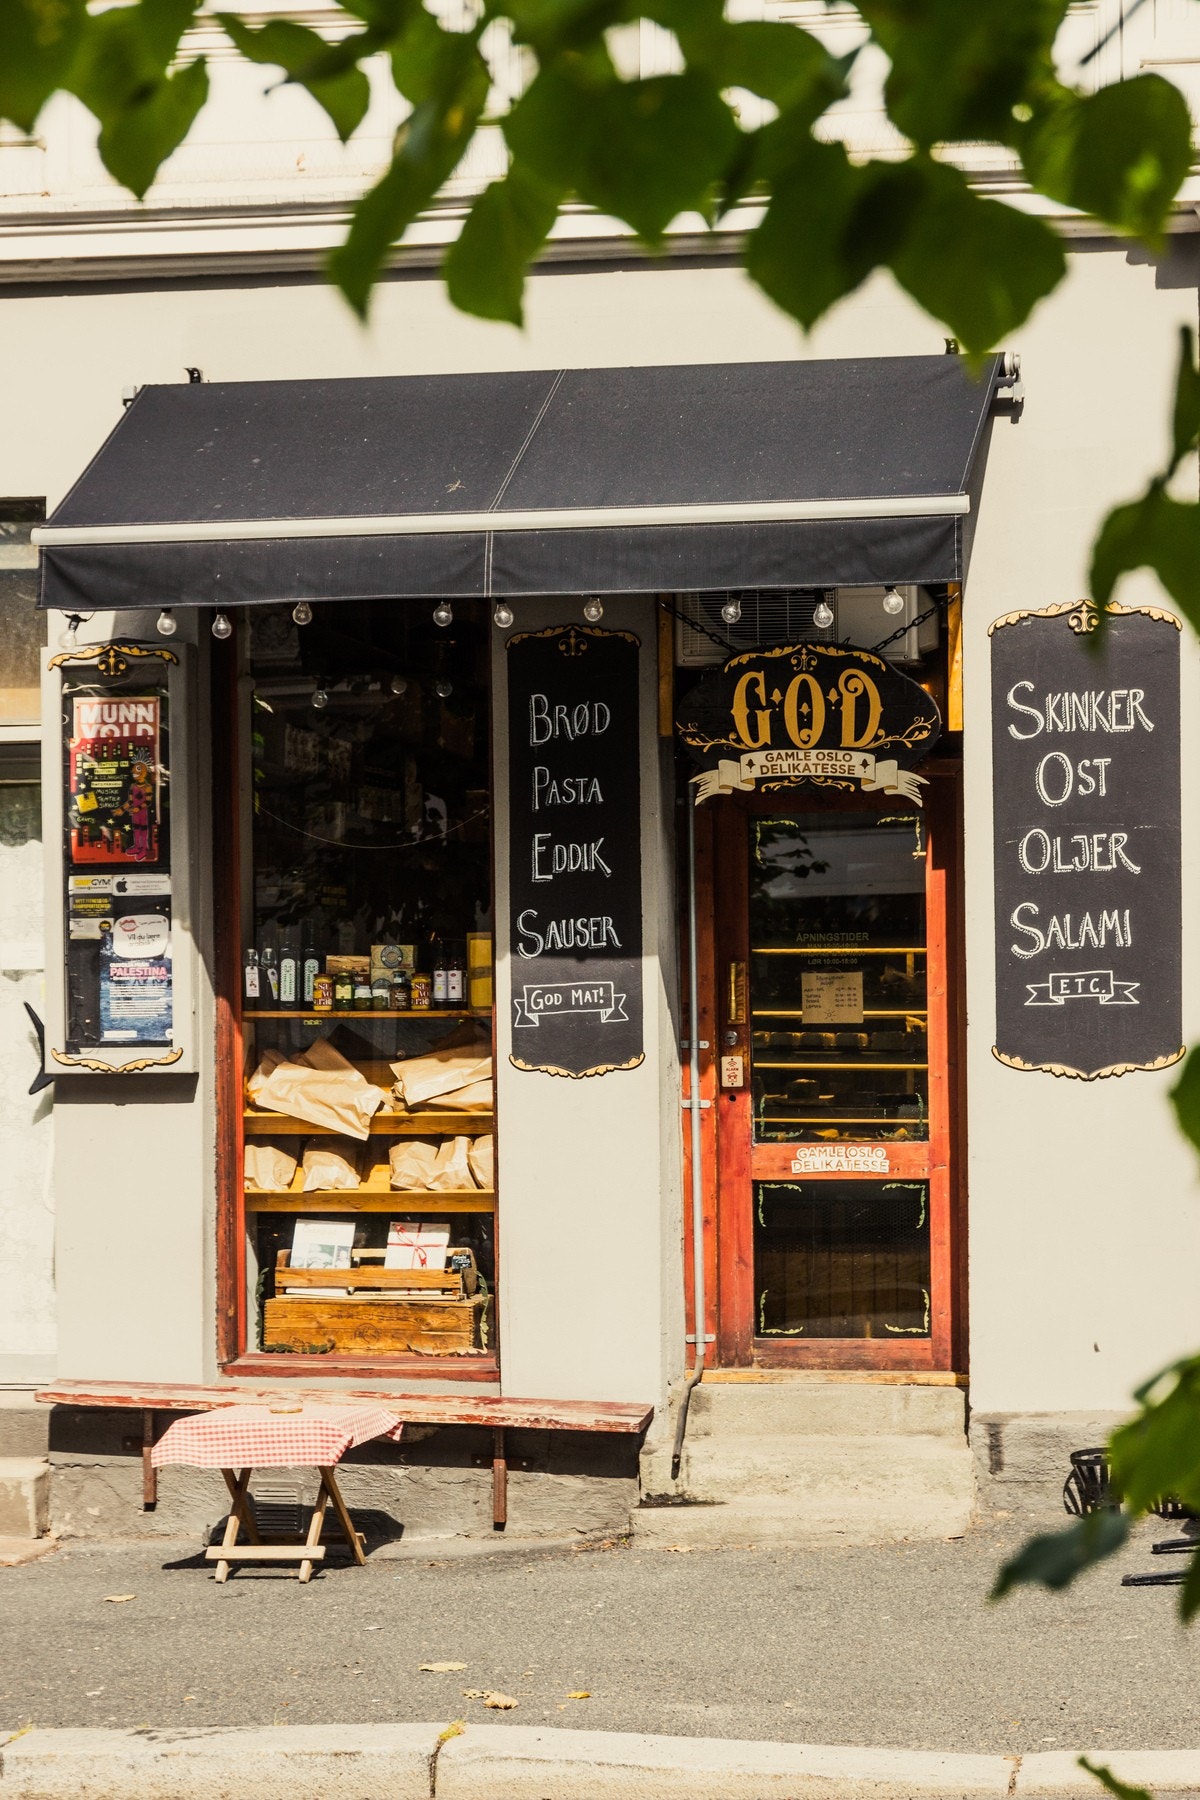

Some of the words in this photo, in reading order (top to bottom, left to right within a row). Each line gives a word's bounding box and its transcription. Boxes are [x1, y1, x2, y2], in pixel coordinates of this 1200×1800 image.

[80, 703, 155, 723] MUNN
[530, 693, 611, 747] BRØD
[730, 668, 883, 749] GOD
[1007, 680, 1154, 740] SKINKER
[759, 762, 856, 775] DELIKATESSE
[765, 751, 812, 763] GAMLE
[815, 751, 853, 763] OSLO
[1035, 751, 1112, 807] OST
[532, 766, 604, 812] PASTA
[531, 833, 612, 883] EDDIK
[1018, 828, 1141, 875] OLJER
[516, 909, 622, 959] SAUSER
[1010, 902, 1132, 959] SALAMI
[109, 966, 168, 977] PALESTINA
[1059, 977, 1106, 994] ETC.
[530, 990, 562, 1010] GOD
[571, 988, 604, 1004] MAT!
[793, 1159, 889, 1173] DELIKATESSE
[797, 1147, 845, 1159] GAMLE
[846, 1147, 886, 1159] OSLO
